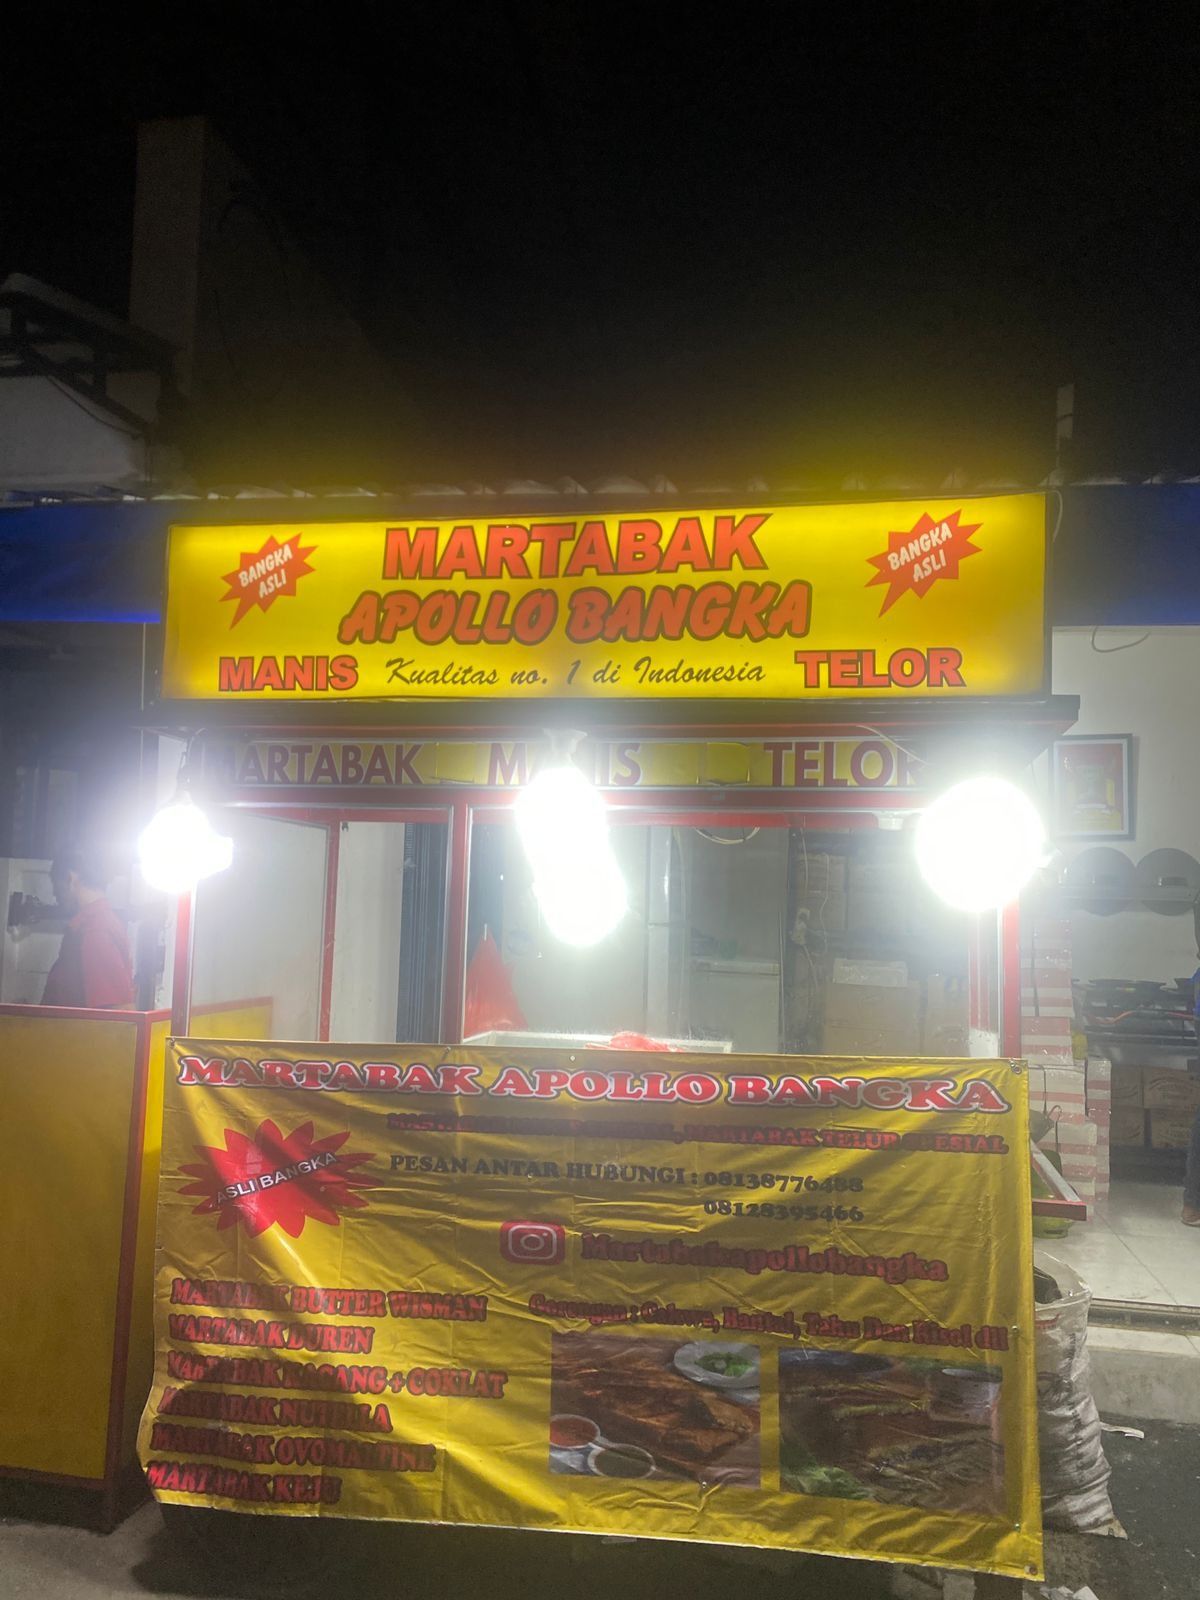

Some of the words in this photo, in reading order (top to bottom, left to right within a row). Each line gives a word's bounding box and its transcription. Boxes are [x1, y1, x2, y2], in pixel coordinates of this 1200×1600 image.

[238, 542, 293, 588] BANGKA
[382, 513, 773, 579] MARTABAK
[886, 522, 953, 570] BANGKA
[912, 549, 947, 582] ASLI
[258, 568, 287, 600] ASLI
[338, 588, 559, 645] APOLLO
[566, 579, 812, 643] BANGKA
[219, 655, 359, 691] MANIS
[386, 657, 498, 685] Kualitas
[510, 668, 548, 685] no.
[567, 658, 579, 684] 1
[594, 657, 620, 684] di
[634, 655, 766, 685] Indonesia
[794, 647, 966, 688] TELOR
[487, 742, 641, 785] MIS
[177, 1056, 484, 1096] MARTABAK
[490, 1063, 722, 1107] APOLLO
[727, 1073, 1012, 1112] BANGKA
[901, 1133, 1009, 1154] ESIAL
[216, 1178, 257, 1204] ASLI
[259, 1151, 337, 1190] BANGKA
[390, 1155, 467, 1173] PESAN
[474, 1158, 560, 1178] ANTAR
[566, 1161, 685, 1184] HUBUNGI
[289, 1285, 387, 1317] BUTTER
[387, 1290, 489, 1322] WISMAN
[168, 1314, 288, 1349] MARTABAK
[287, 1321, 375, 1354] DUREN
[387, 1371, 405, 1394] +
[404, 1367, 509, 1398] COKLAT
